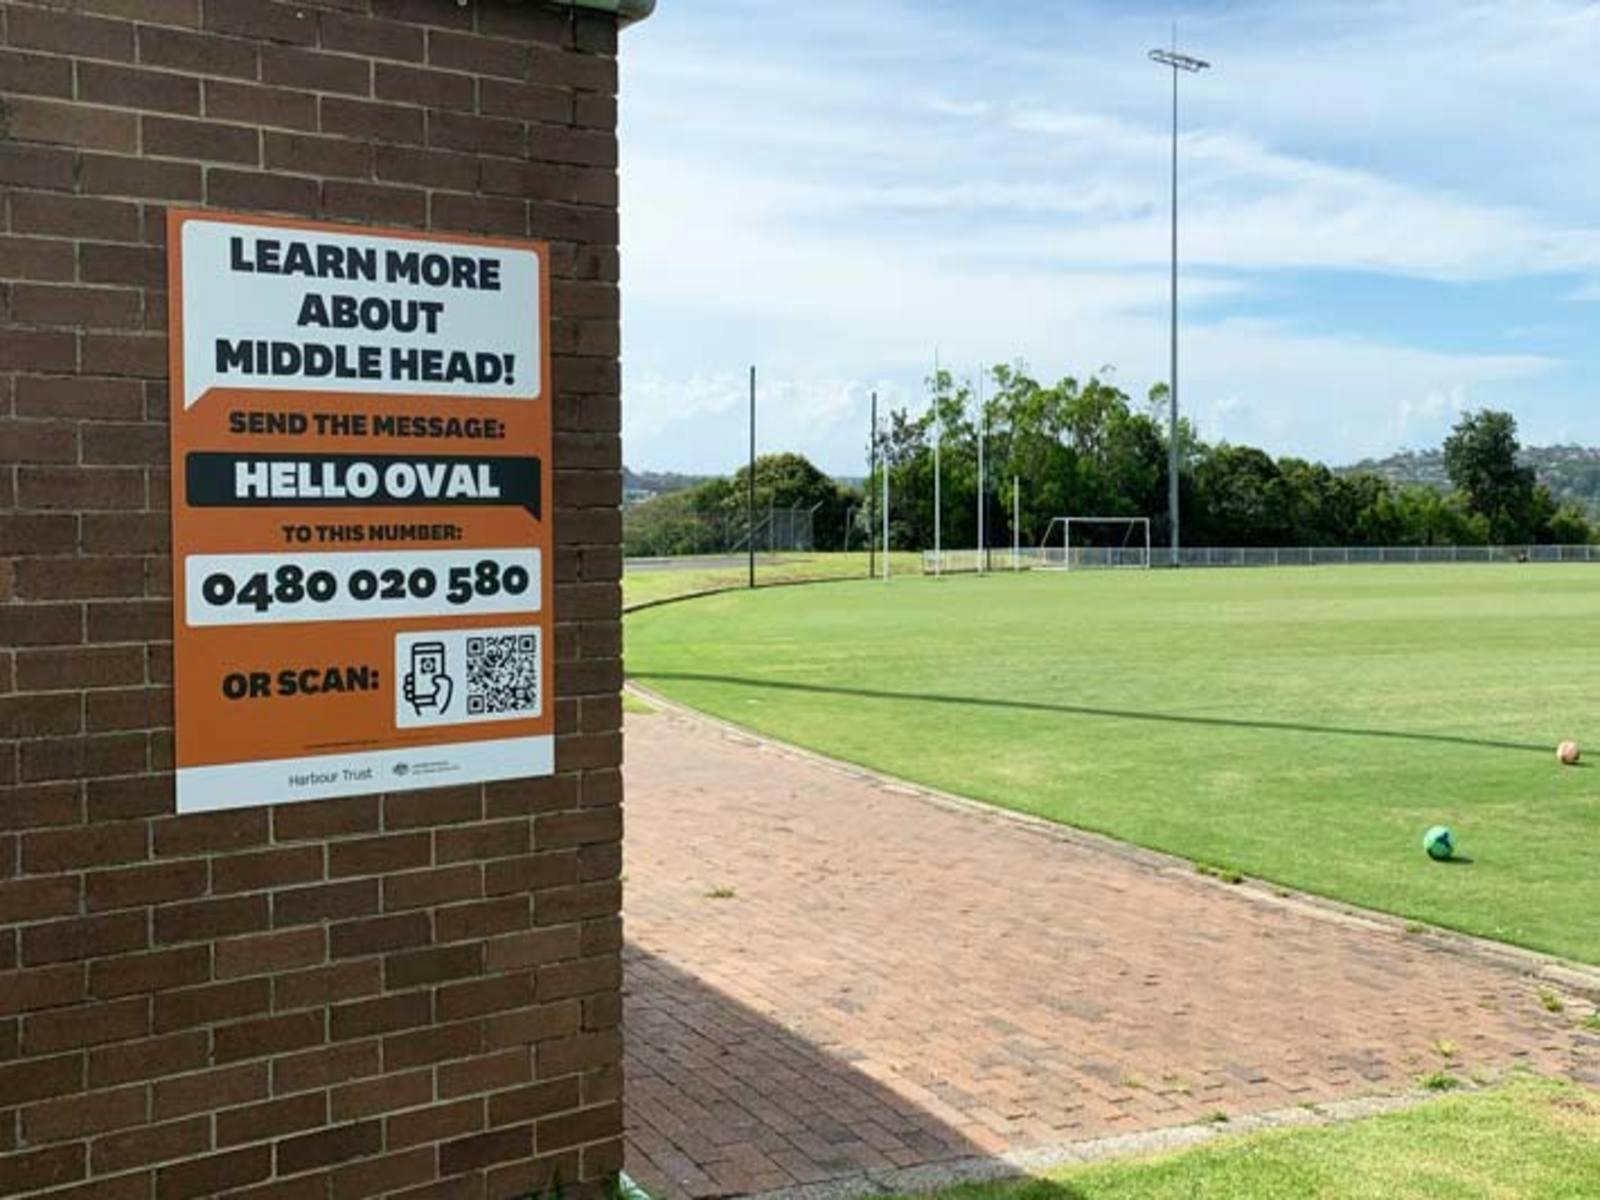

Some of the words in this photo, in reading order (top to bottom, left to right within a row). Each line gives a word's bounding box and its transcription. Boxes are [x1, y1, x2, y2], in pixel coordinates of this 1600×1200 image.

[230, 237, 376, 281] LEARN
[386, 250, 501, 290] MORE
[297, 293, 444, 333] ABOUT
[215, 339, 382, 379] MIDDLE
[390, 349, 515, 385] HEAD!
[229, 411, 308, 435] SEND
[314, 414, 367, 437] THE
[373, 415, 506, 439] MESSAGE:
[234, 461, 380, 498] HELLO
[384, 463, 500, 498] OVAL
[282, 525, 311, 543] TO
[315, 525, 367, 542] THIS
[368, 524, 463, 541] NUMBER:
[202, 564, 337, 612] 0480
[348, 568, 436, 600] 020
[446, 560, 530, 605] 580
[222, 673, 277, 700] OR
[278, 667, 379, 696] SCAN:
[288, 771, 338, 787] Harbour
[342, 767, 373, 781] Trust
